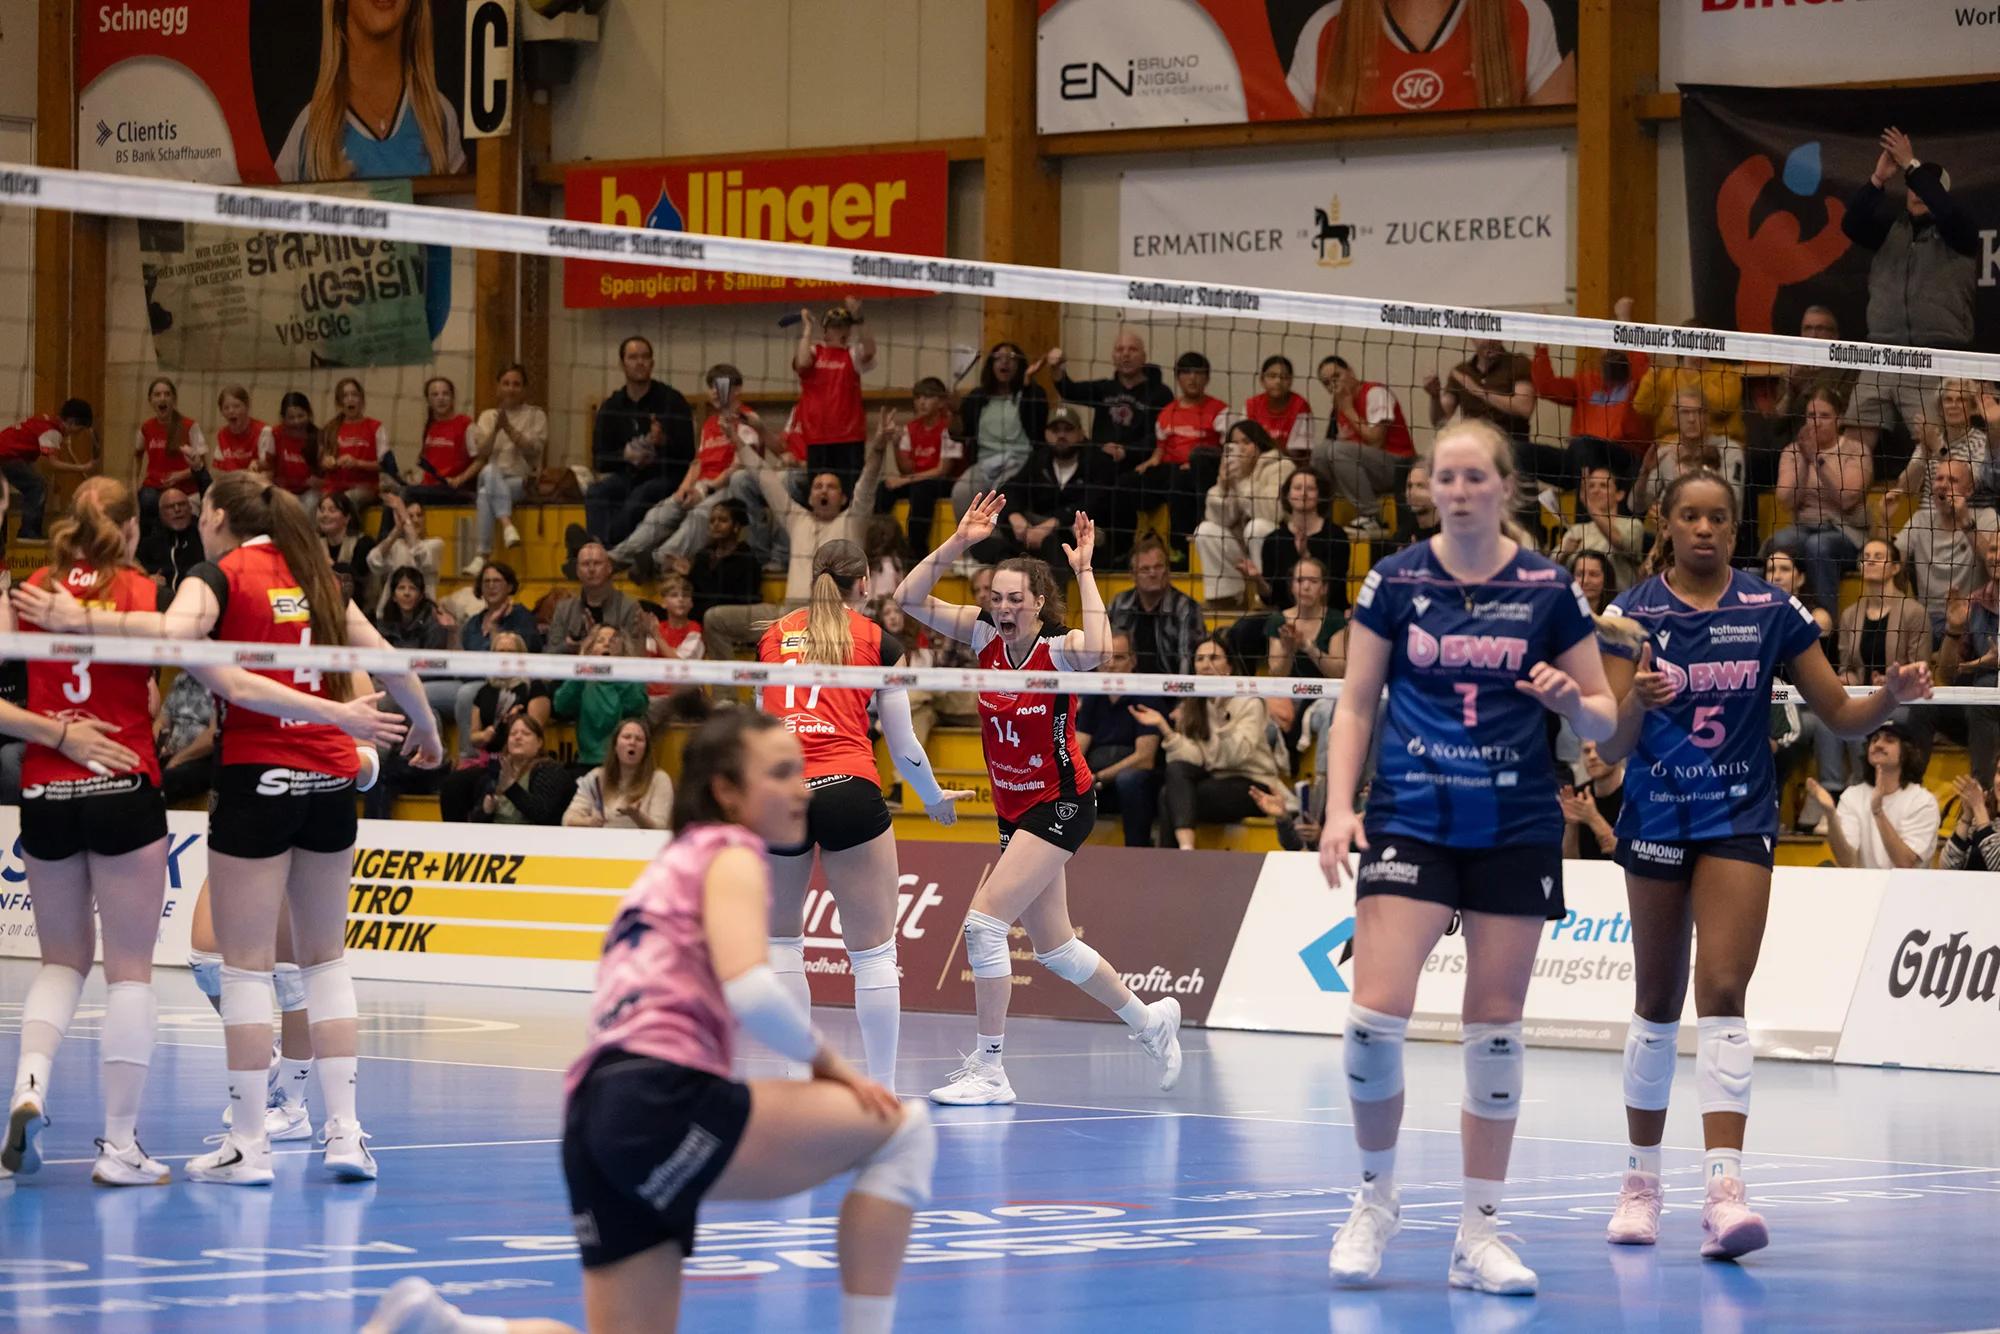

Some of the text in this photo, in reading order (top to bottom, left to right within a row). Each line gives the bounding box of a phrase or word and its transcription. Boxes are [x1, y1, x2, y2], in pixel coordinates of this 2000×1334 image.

[99, 3, 189, 36] Schnegg
[1955, 7, 2000, 27] Wor
[471, 2, 508, 133] C
[1137, 55, 1199, 71] BRUNO
[1403, 77, 1434, 99] SIG
[116, 120, 177, 143] Clientis
[116, 146, 222, 163] BS Bank Schaffhausen
[1134, 228, 1283, 258] ERMATINGER
[1385, 213, 1552, 245] ZUCKERBECK
[1709, 624, 1757, 636] hoffmann
[1711, 634, 1757, 645] automobile
[1439, 634, 1528, 671] BWT
[62, 659, 92, 703] 3
[1688, 660, 1760, 692] BWT
[1016, 704, 1046, 715] sasag
[1454, 683, 1479, 727] 7
[990, 716, 1020, 748] 14
[1688, 705, 1726, 749] 5
[1431, 742, 1520, 761] NOVARTIS
[1674, 760, 1749, 779] NOVARTIS
[803, 957, 848, 976] ndheit
[1118, 964, 1204, 997] rofit.ch
